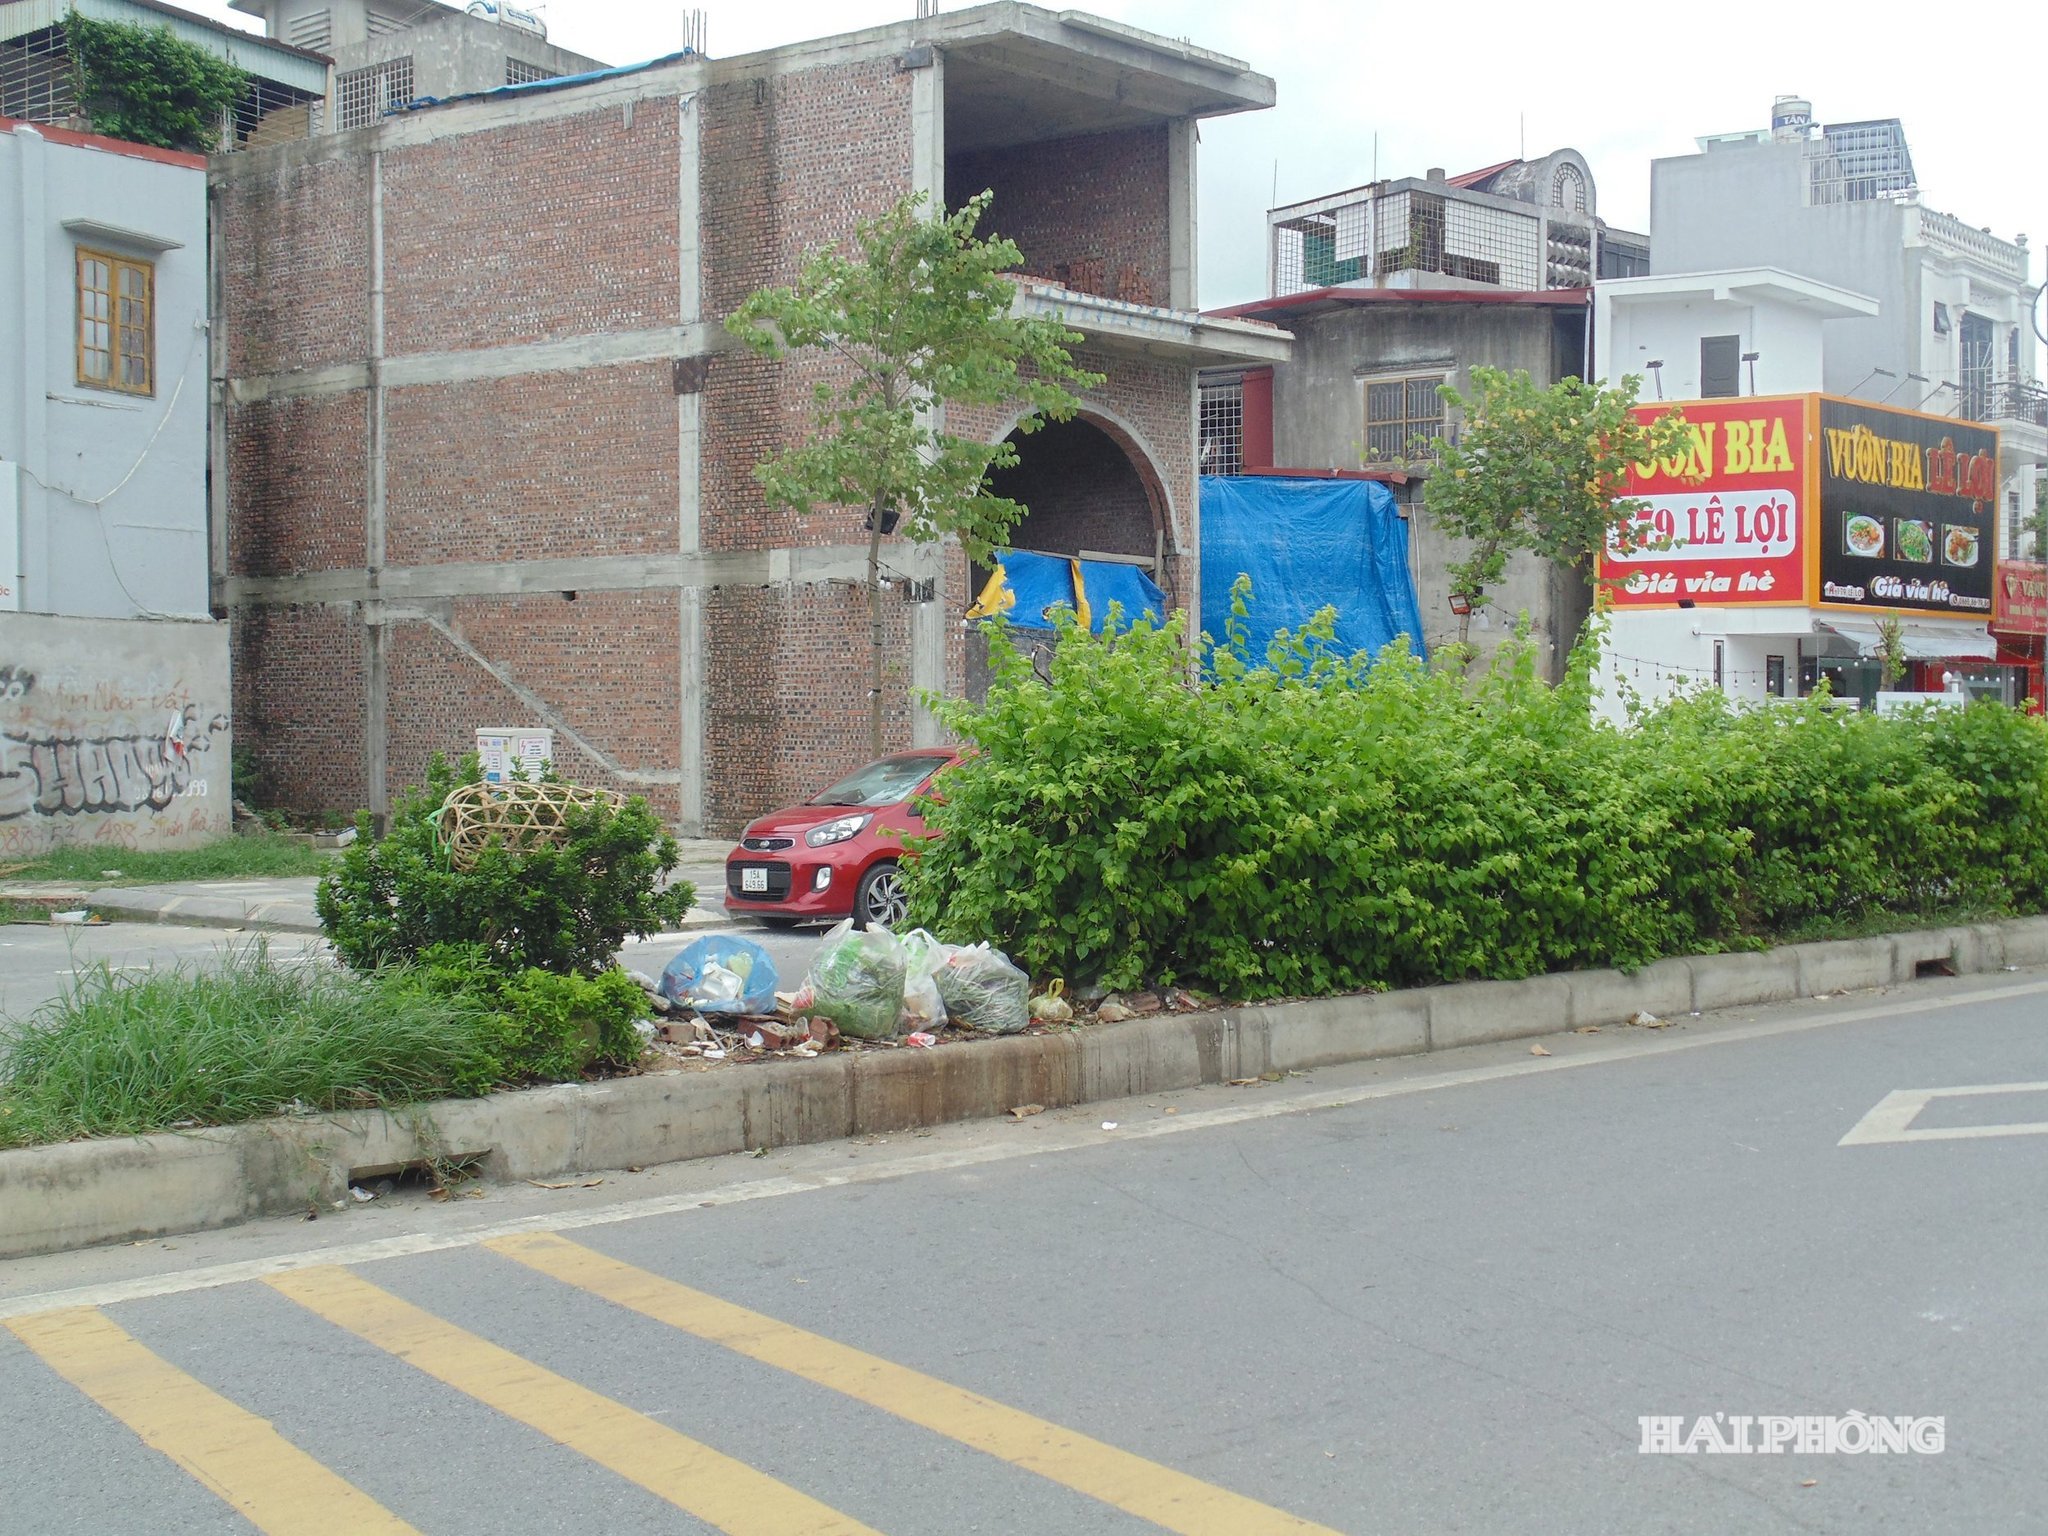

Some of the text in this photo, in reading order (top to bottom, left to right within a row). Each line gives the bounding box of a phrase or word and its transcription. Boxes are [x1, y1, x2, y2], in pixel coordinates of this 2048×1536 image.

[1724, 417, 1794, 475] BIA
[1824, 423, 1924, 491] VƯỜN BIA
[1926, 436, 1957, 496] LÊ
[1687, 495, 1725, 545] LÊ
[1735, 497, 1789, 555] LỢI
[1625, 569, 1776, 595] Giá vỉa hè
